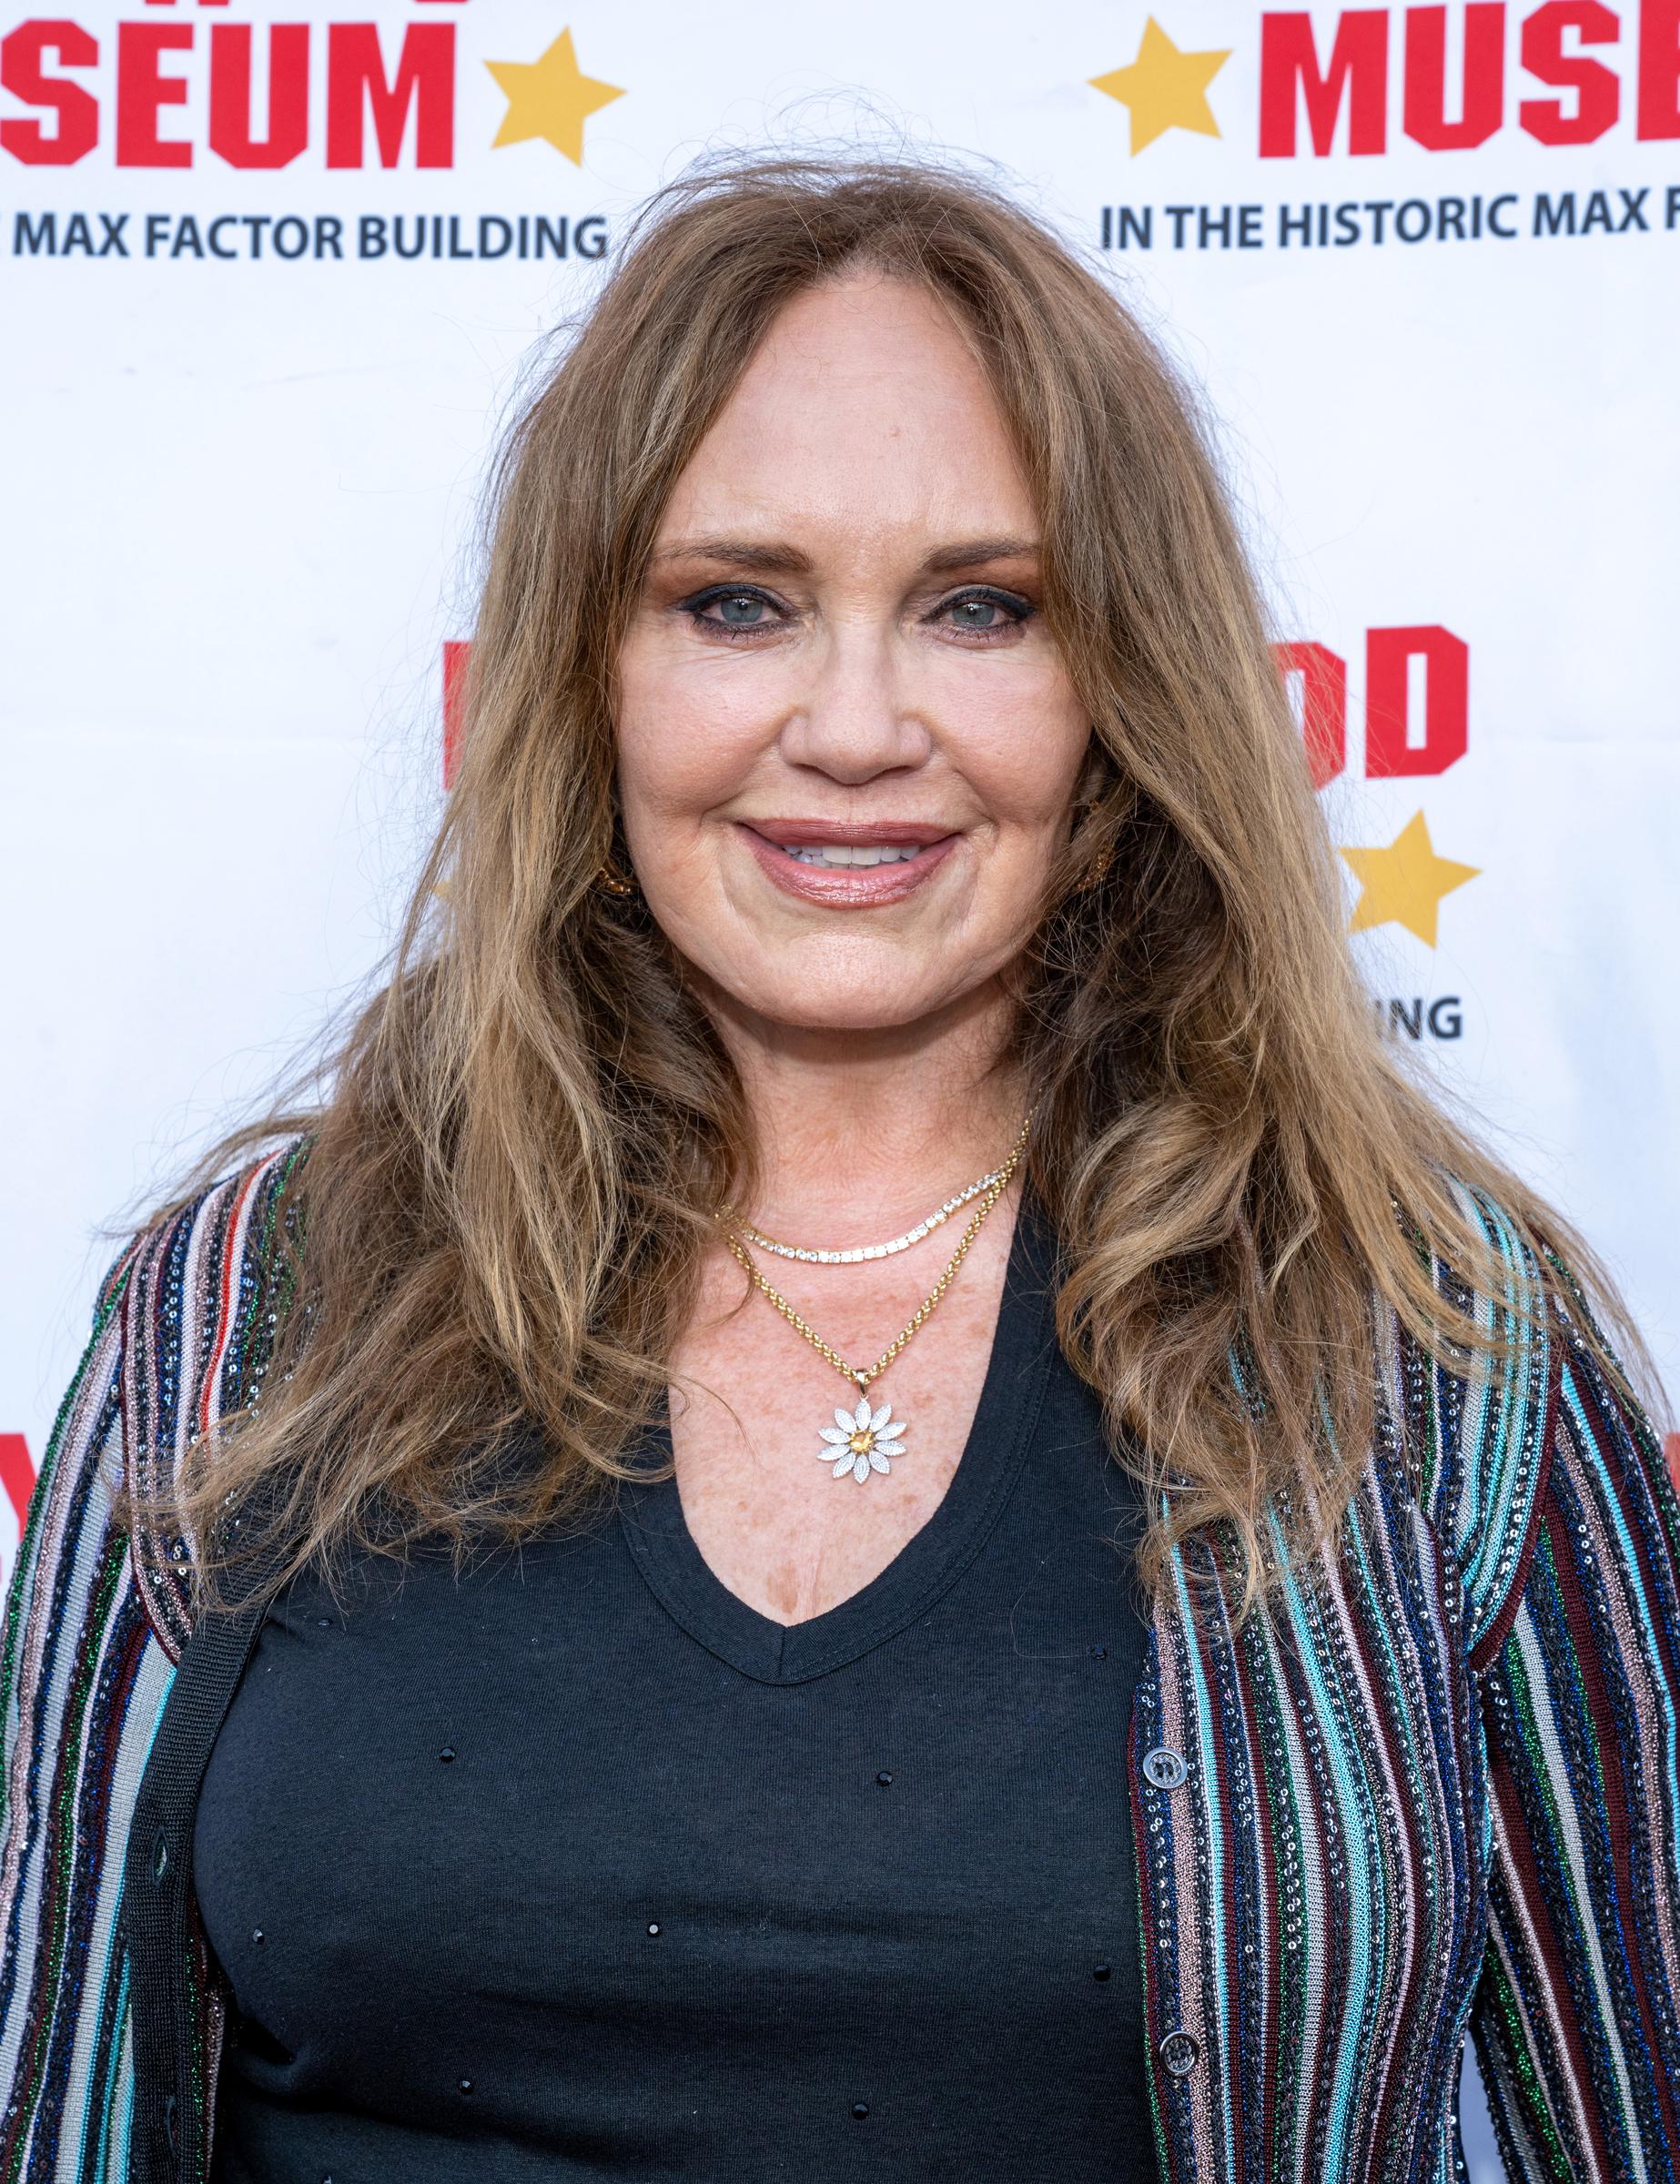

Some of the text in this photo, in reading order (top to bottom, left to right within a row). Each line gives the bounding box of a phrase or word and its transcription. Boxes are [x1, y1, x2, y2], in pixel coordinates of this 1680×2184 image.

[0, 19, 456, 169] SEUM
[13, 212, 609, 261] MAX FACTOR BUILDING
[1101, 207, 1151, 250] IN
[1165, 205, 1263, 249] THE
[1279, 194, 1518, 248] HISTORIC
[1532, 187, 1649, 237] MAX
